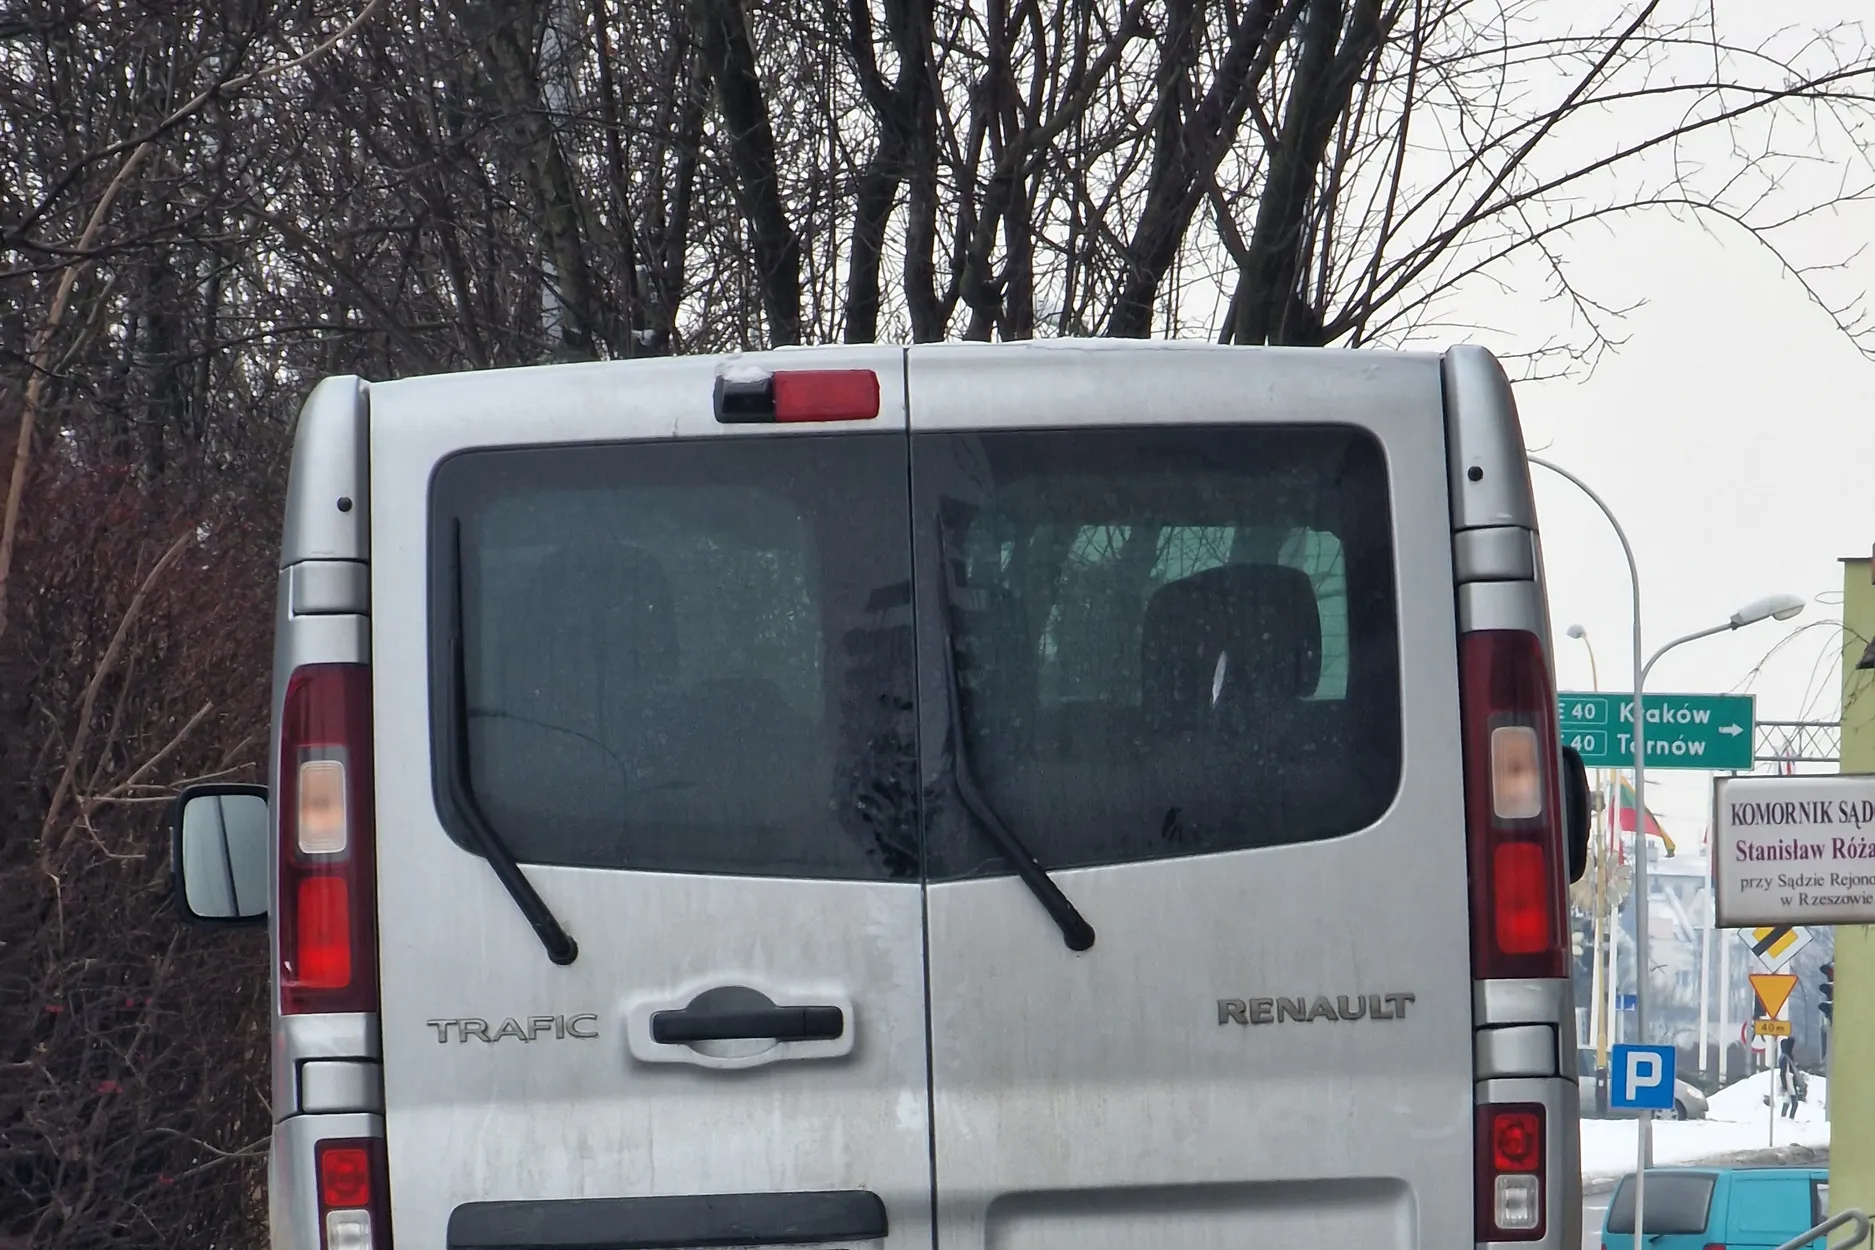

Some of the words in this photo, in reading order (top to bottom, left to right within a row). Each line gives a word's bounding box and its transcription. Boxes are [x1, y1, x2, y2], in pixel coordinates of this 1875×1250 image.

[1572, 703, 1596, 720] 40
[1620, 702, 1711, 724] Kaków
[1570, 734, 1595, 751] 40
[1731, 801, 1834, 826] KOMORNIK
[1838, 800, 1875, 829] SĄD
[1736, 838, 1825, 861] Stanisław
[1740, 877, 1773, 892] przy
[1778, 873, 1825, 890] Sądzie
[1780, 896, 1793, 906] w
[1799, 891, 1873, 906] Rzeszowie
[1217, 993, 1416, 1026] RENAULT
[426, 1013, 599, 1044] TRAFIC
[1626, 1051, 1662, 1101] P
